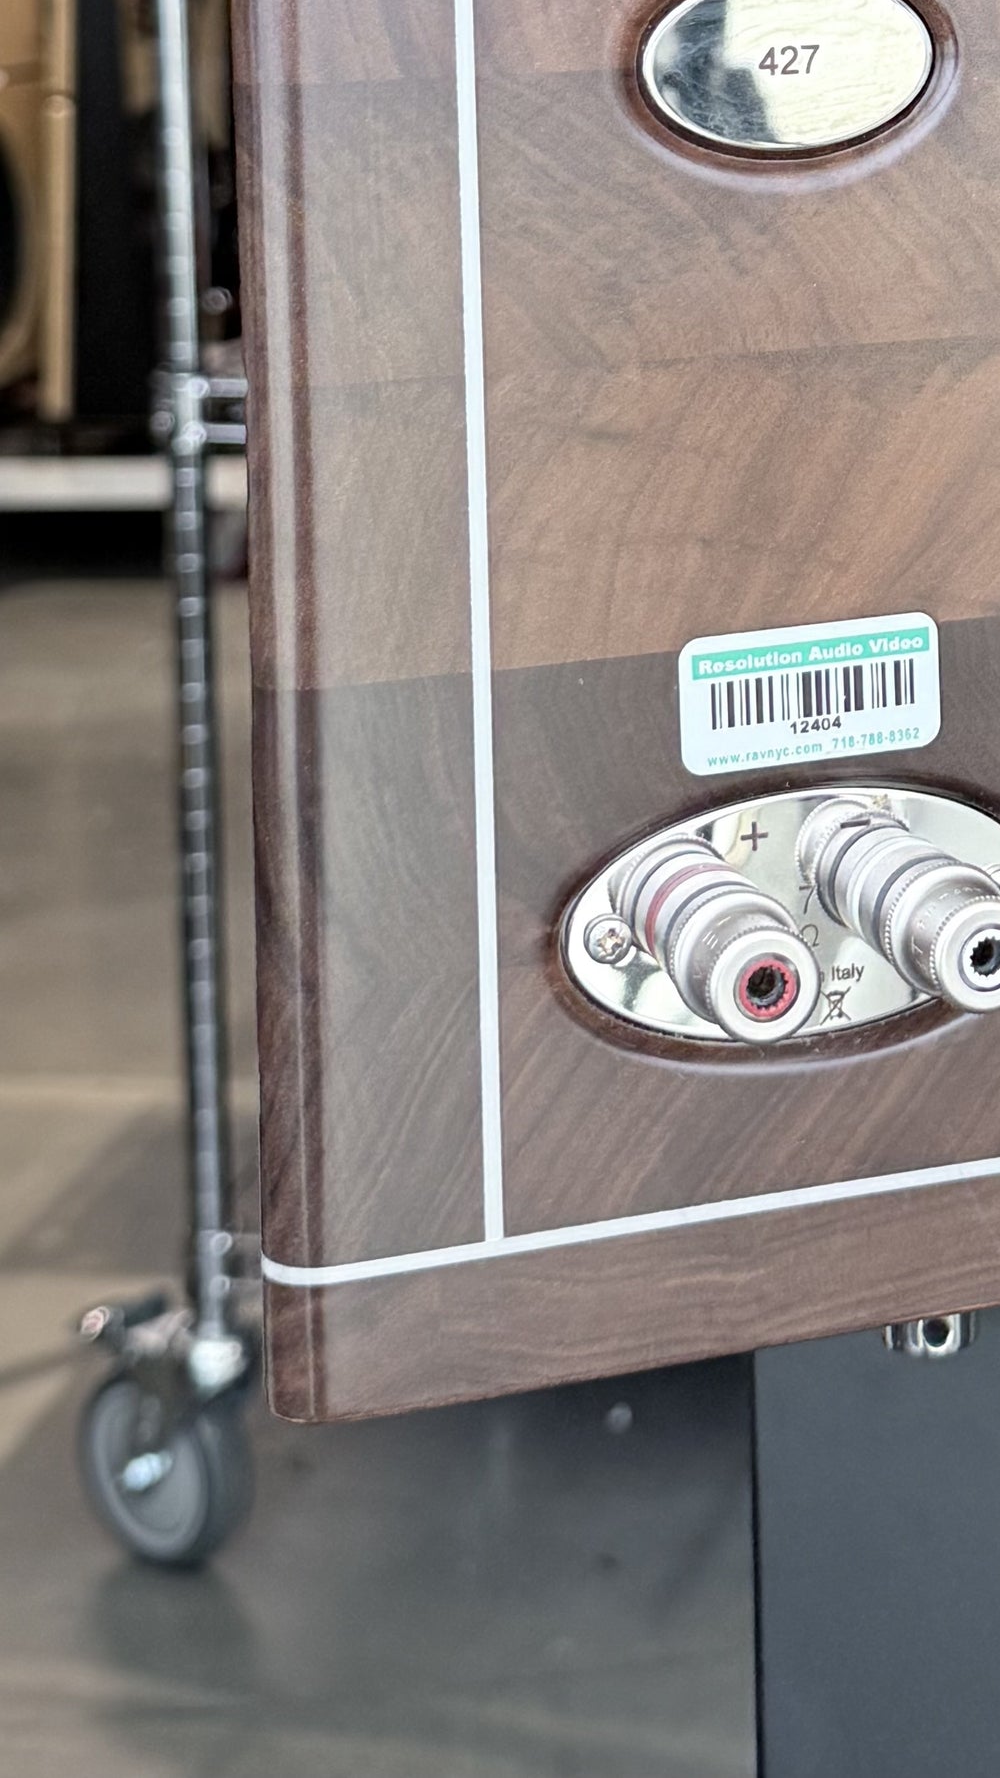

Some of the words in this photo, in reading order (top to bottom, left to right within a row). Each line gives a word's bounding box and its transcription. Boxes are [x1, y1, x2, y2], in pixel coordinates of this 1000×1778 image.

[758, 44, 820, 76] 427
[698, 649, 803, 676] Resolution
[808, 640, 864, 662] Audio
[868, 634, 924, 655] Video
[789, 715, 843, 735] 12404
[707, 741, 823, 767] www.ravnyc.com
[831, 726, 921, 750] 718-788-8362
[831, 962, 865, 982] Italy
